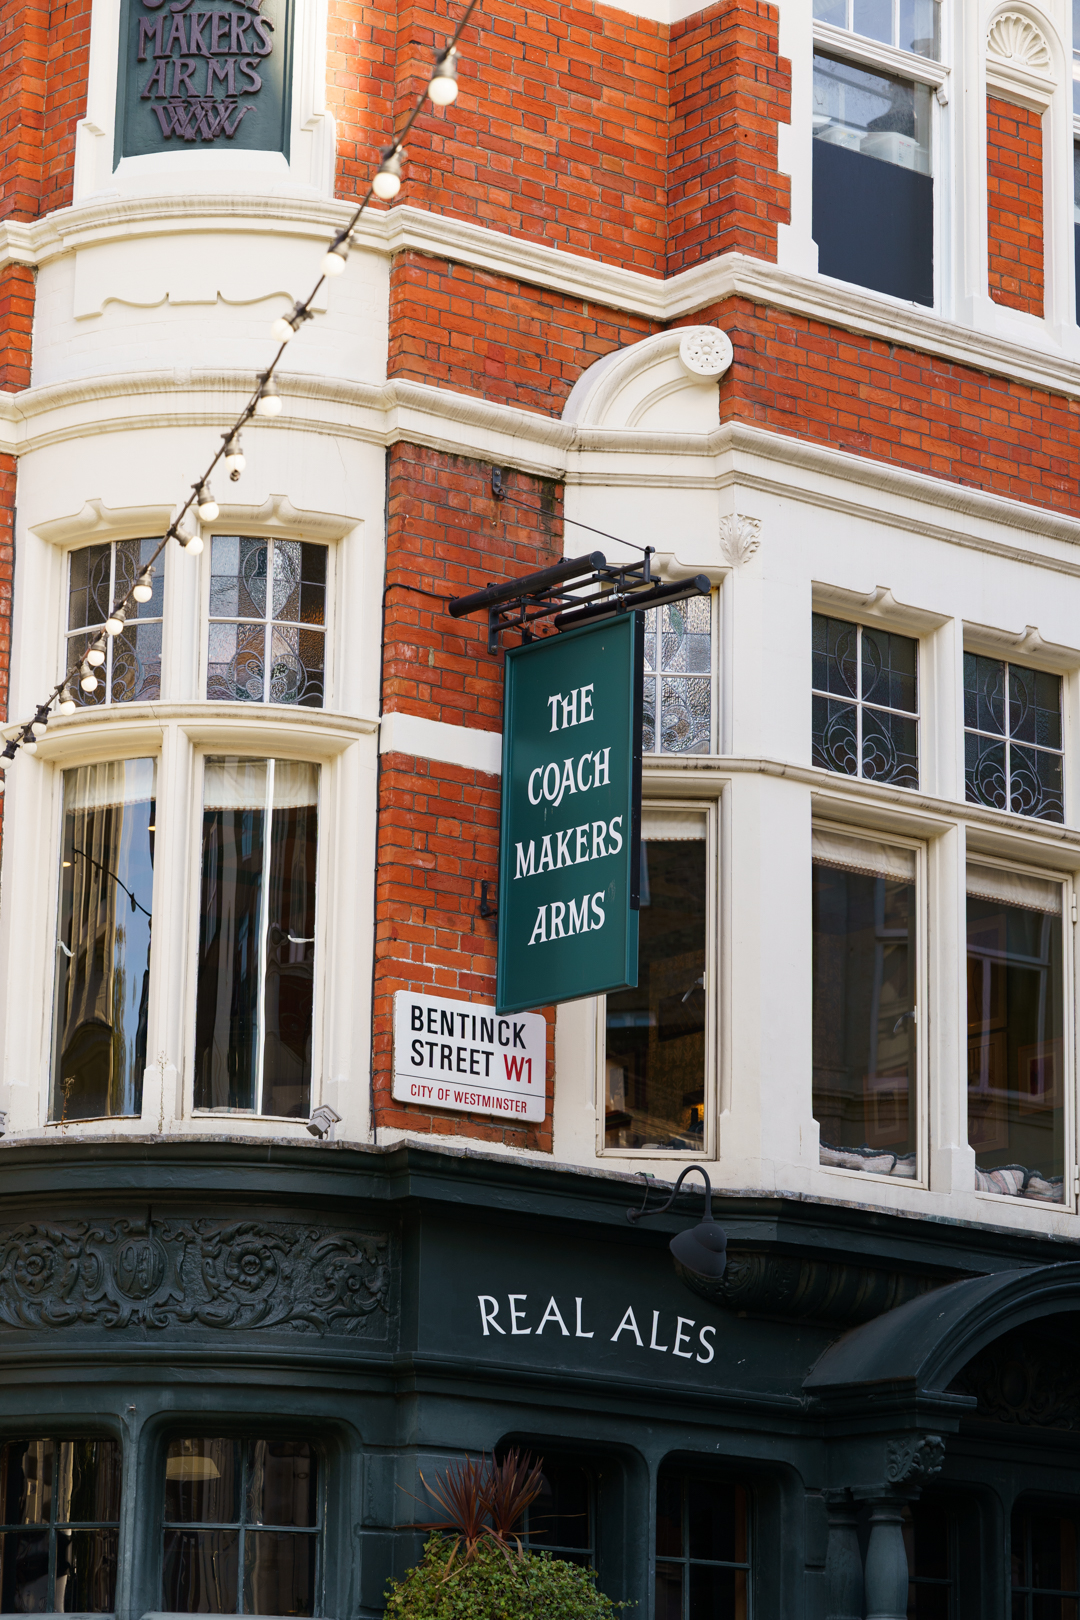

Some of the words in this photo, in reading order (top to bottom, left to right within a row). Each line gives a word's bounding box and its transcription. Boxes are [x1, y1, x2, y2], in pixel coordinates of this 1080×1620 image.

[137, 12, 275, 62] MAKERS
[140, 58, 262, 100] ARMS
[547, 683, 595, 733] THE
[528, 747, 612, 807] COACH
[513, 815, 623, 880] MAKERS
[528, 890, 606, 945] ARMS
[411, 1005, 526, 1049] BENTINCK
[411, 1039, 494, 1077] STREET
[503, 1054, 532, 1084] W1
[410, 1084, 434, 1098] CITY
[437, 1088, 451, 1101] OF
[454, 1090, 527, 1113] WESTMINSTER
[477, 1294, 594, 1338] REAL
[610, 1305, 717, 1364] ALES
